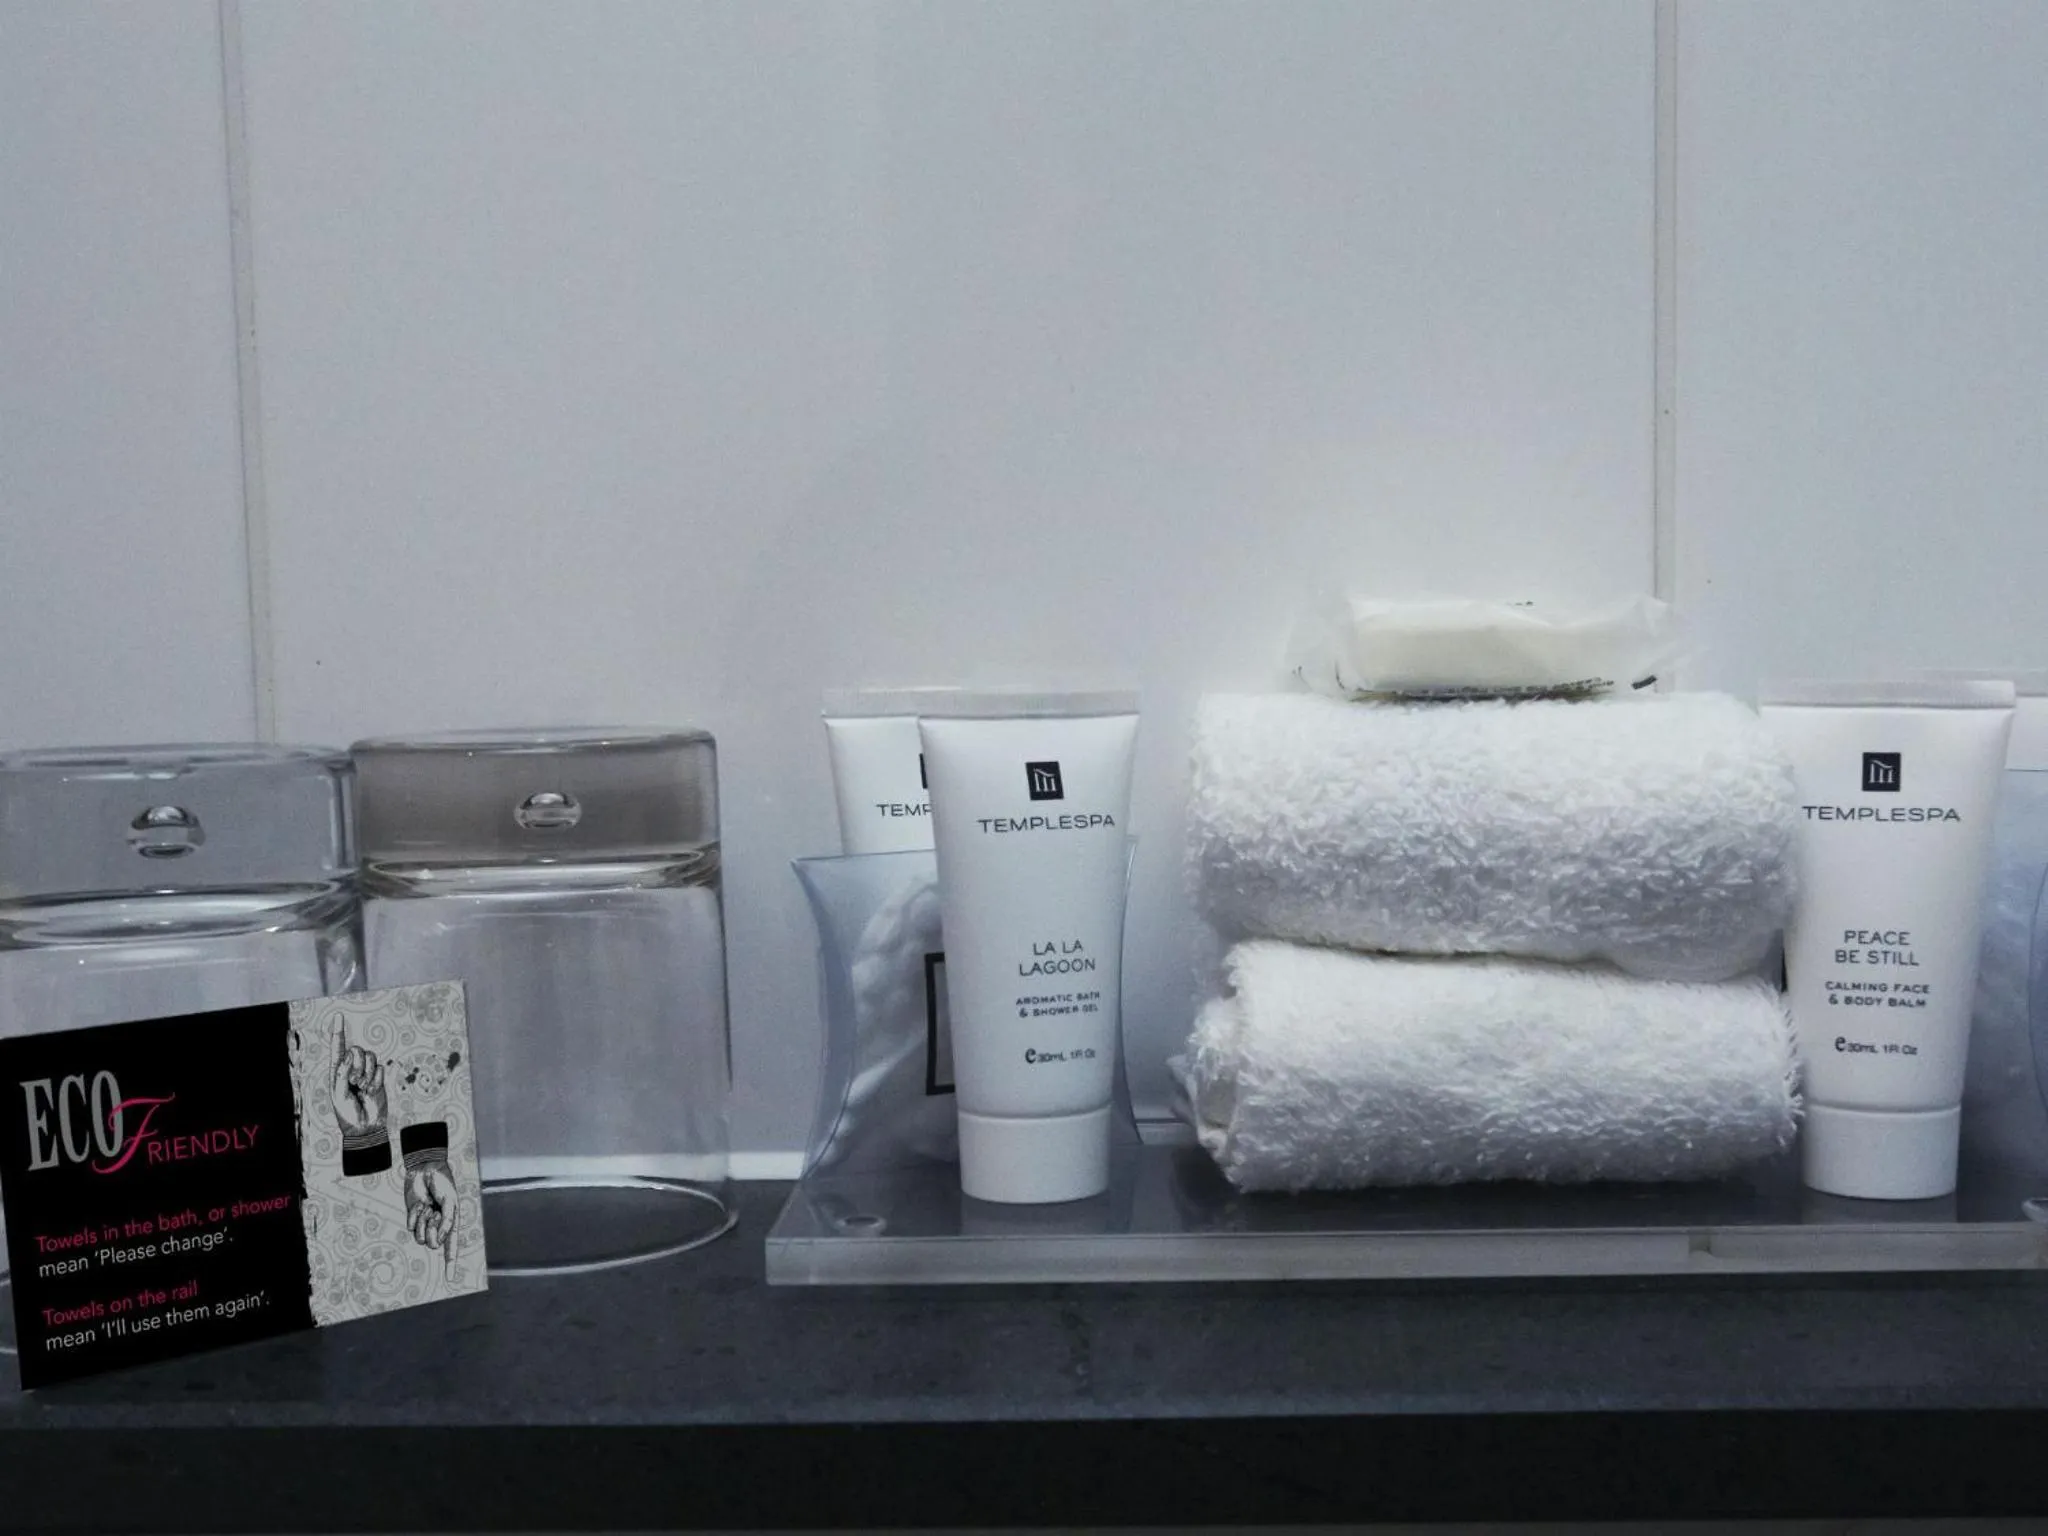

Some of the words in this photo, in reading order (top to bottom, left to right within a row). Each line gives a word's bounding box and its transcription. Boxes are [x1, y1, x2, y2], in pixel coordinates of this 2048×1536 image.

[1802, 805, 1961, 822] TEMPLESPA
[977, 814, 1116, 833] TEMPLESPA
[1844, 930, 1911, 946] PEACE
[1033, 941, 1056, 956] LA
[1062, 939, 1083, 954] LA
[1835, 949, 1860, 964] BE
[1867, 950, 1919, 967] STILL
[1019, 958, 1096, 977] LAGOON
[1825, 981, 1888, 992] CALMING
[1894, 983, 1930, 994] FACE
[1016, 993, 1073, 1005] AROMATIC
[1844, 996, 1882, 1006] BODY
[1888, 998, 1926, 1008] BALM
[1033, 1005, 1079, 1017] SHOWER
[20, 1070, 123, 1171] ECO
[36, 1228, 98, 1253] Towels
[103, 1224, 119, 1241] in
[124, 1217, 153, 1238] the
[158, 1208, 203, 1231] bath,
[208, 1208, 226, 1223] or
[231, 1194, 292, 1218] shower
[38, 1256, 89, 1278] mean
[42, 1300, 105, 1327] Towels
[109, 1298, 133, 1314] on
[138, 1288, 167, 1308] the
[172, 1280, 199, 1301] rail
[45, 1329, 96, 1351] mean
[131, 1317, 162, 1334] use
[165, 1306, 211, 1328] them
